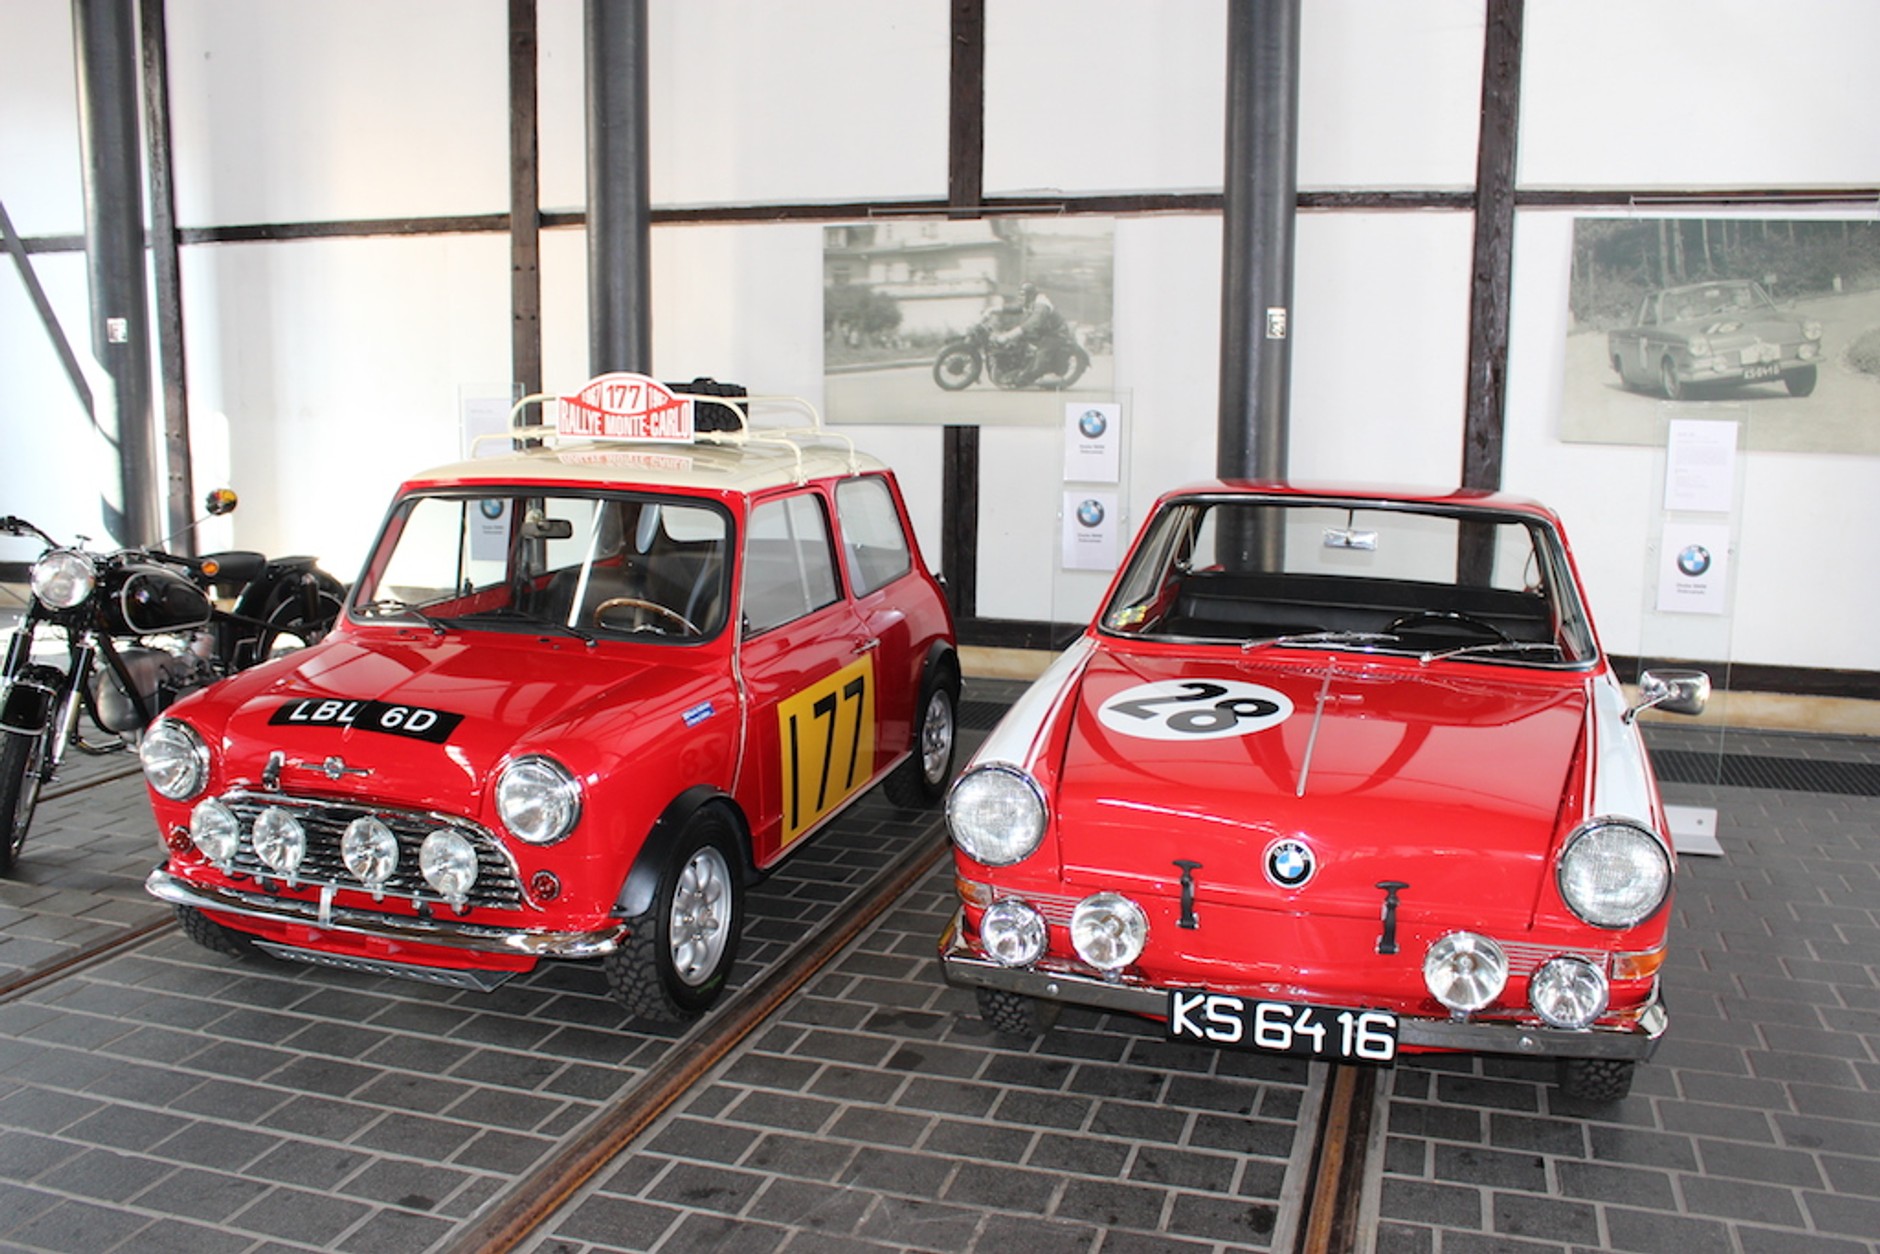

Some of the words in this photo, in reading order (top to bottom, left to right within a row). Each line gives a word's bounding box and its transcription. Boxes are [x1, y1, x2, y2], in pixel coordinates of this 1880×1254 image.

[606, 384, 641, 409] 177
[560, 400, 602, 436] RALLYE
[604, 401, 690, 438] MONTE-CARLO
[288, 700, 358, 723] LBL
[380, 705, 438, 732] 6D
[1107, 682, 1280, 734] 28
[789, 675, 865, 831] 177
